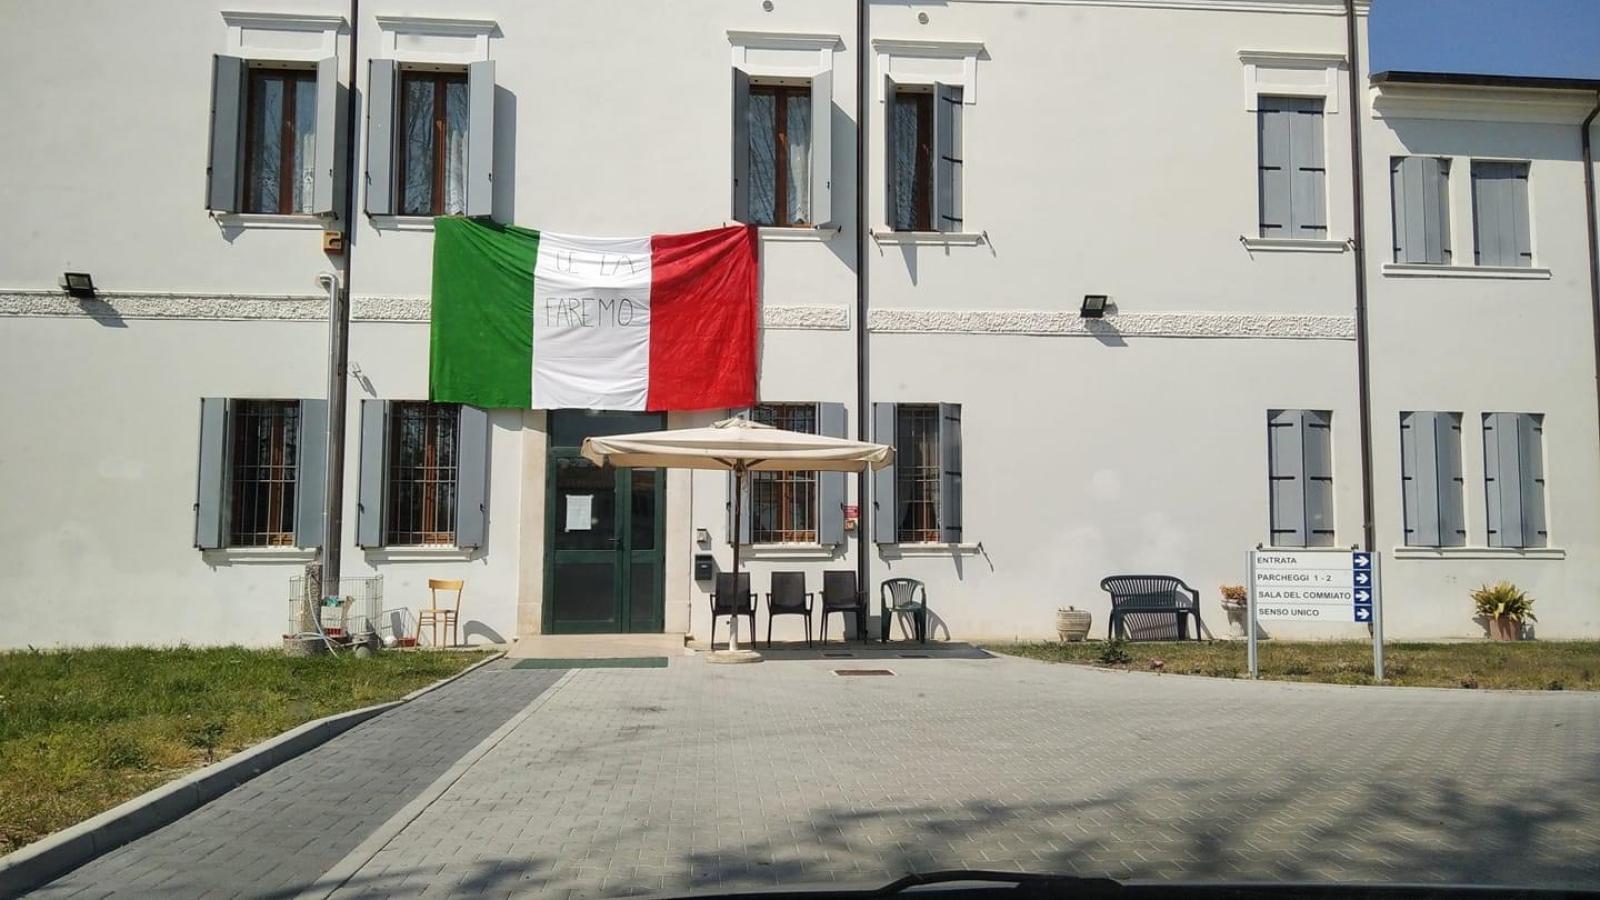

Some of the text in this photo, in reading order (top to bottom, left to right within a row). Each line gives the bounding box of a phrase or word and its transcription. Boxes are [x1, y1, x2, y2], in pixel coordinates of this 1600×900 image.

[599, 252, 635, 276] LA
[545, 297, 633, 328] FAREMO
[1257, 556, 1297, 564] ENTRATA
[1257, 574, 1309, 582] PARCHEGGI
[1258, 591, 1351, 600] SALA DEL COMMIATO
[1259, 608, 1289, 616] SENSO
